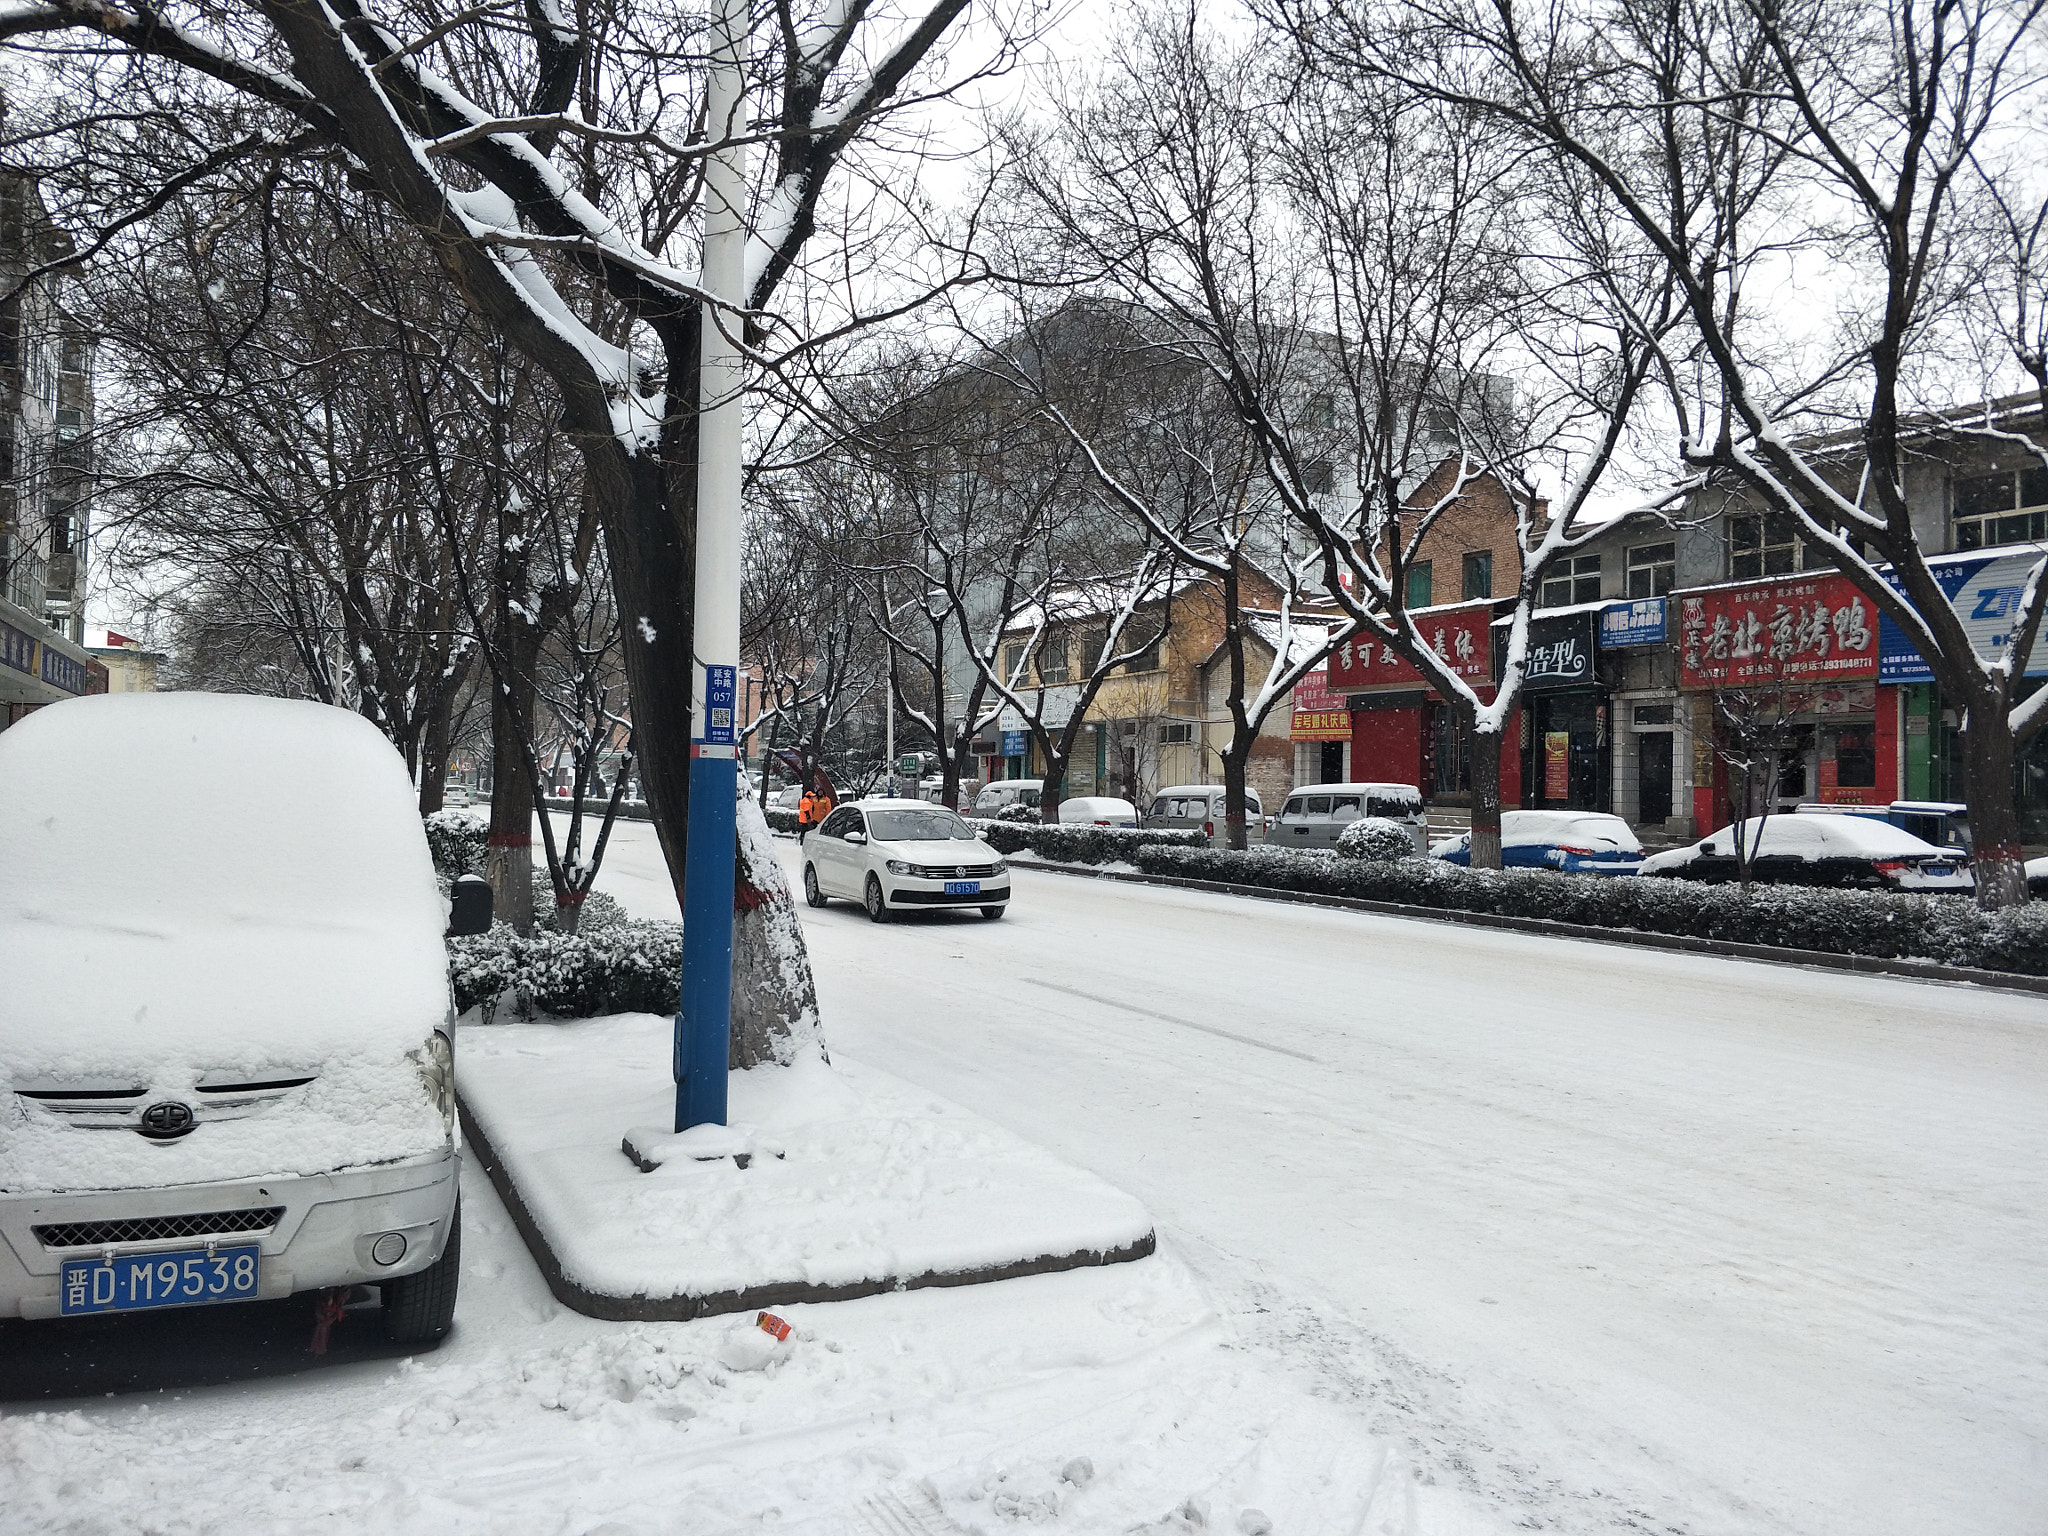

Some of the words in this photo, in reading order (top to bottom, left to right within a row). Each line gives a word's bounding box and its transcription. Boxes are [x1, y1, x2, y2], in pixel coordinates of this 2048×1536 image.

[1935, 567, 1963, 579] 分公司
[1703, 596, 1872, 662] 老北京烤鸭
[714, 679, 731, 688] 中路
[714, 692, 731, 702] 057
